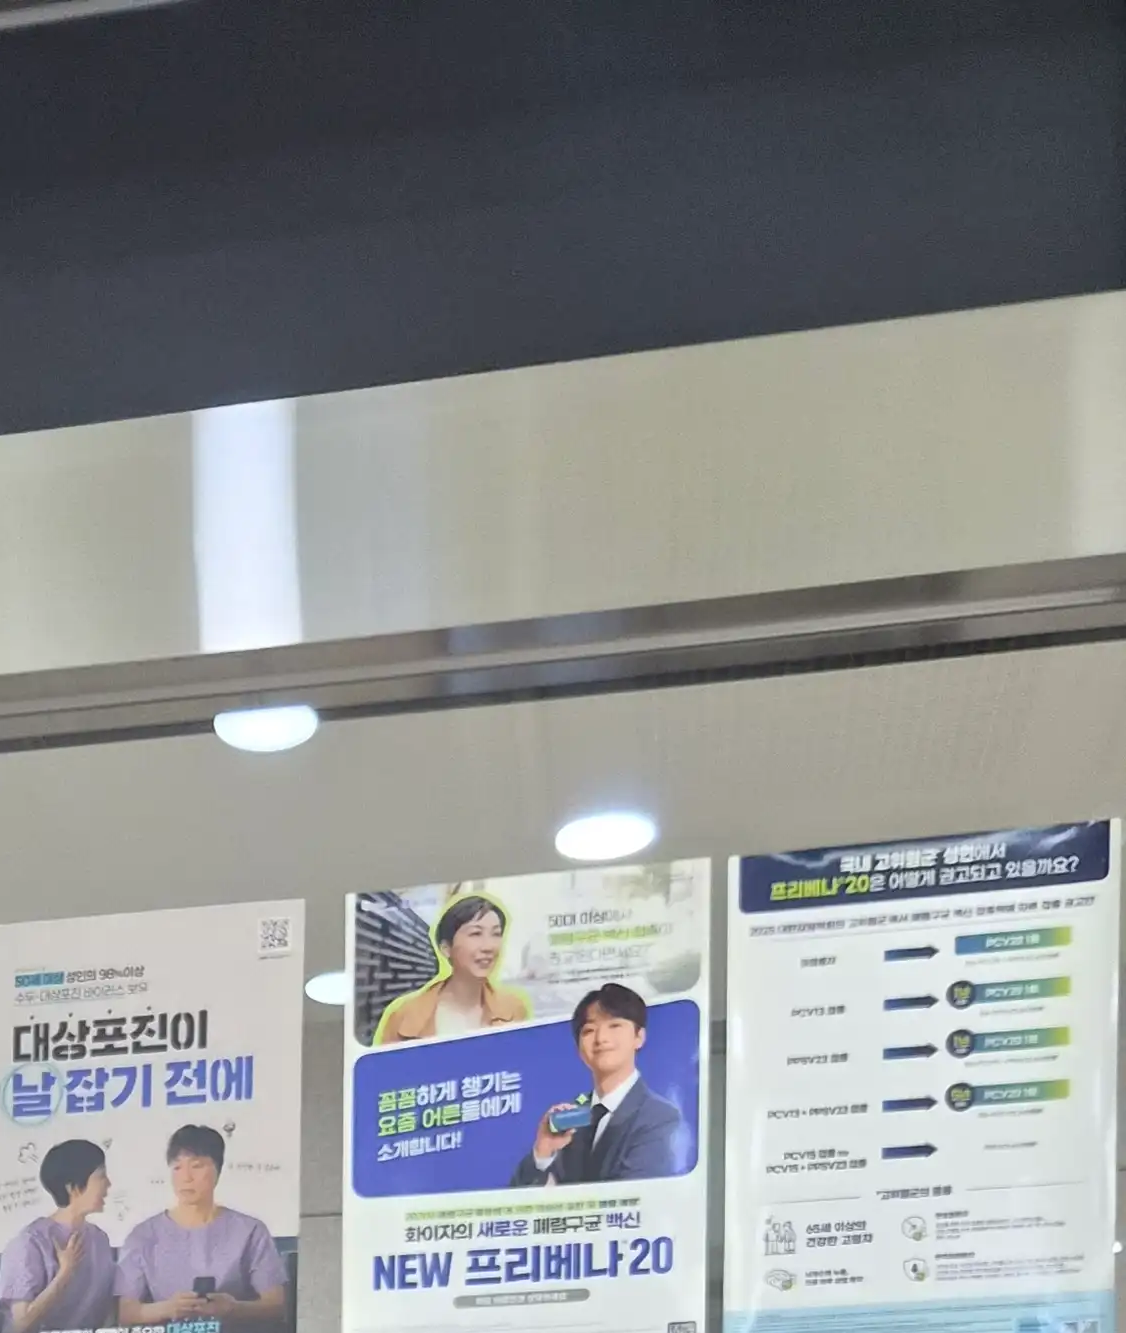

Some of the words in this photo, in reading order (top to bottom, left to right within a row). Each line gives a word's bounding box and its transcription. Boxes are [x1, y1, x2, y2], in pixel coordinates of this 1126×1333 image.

[840, 854, 872, 873] 국내
[889, 871, 935, 891] 어떻게
[939, 863, 1002, 886] 권고되고
[1006, 856, 1080, 879] 있을까요?
[13, 1009, 208, 1063] 대상포진이
[12, 1071, 57, 1118] 날
[65, 1064, 152, 1114] 잡기
[164, 1055, 254, 1106] 전에
[378, 1080, 457, 1113] 꼼꼼하게
[461, 1071, 522, 1099] 챙기는
[378, 1112, 417, 1137] 요즘
[423, 1092, 522, 1129] 어른들에게
[377, 1130, 462, 1162] 소개합니다!
[405, 1222, 473, 1243] 화이자의
[477, 1219, 528, 1238] 새로운
[533, 1214, 602, 1235] 폐렴구균
[606, 1211, 641, 1229] 백신
[373, 1251, 453, 1291] NEW
